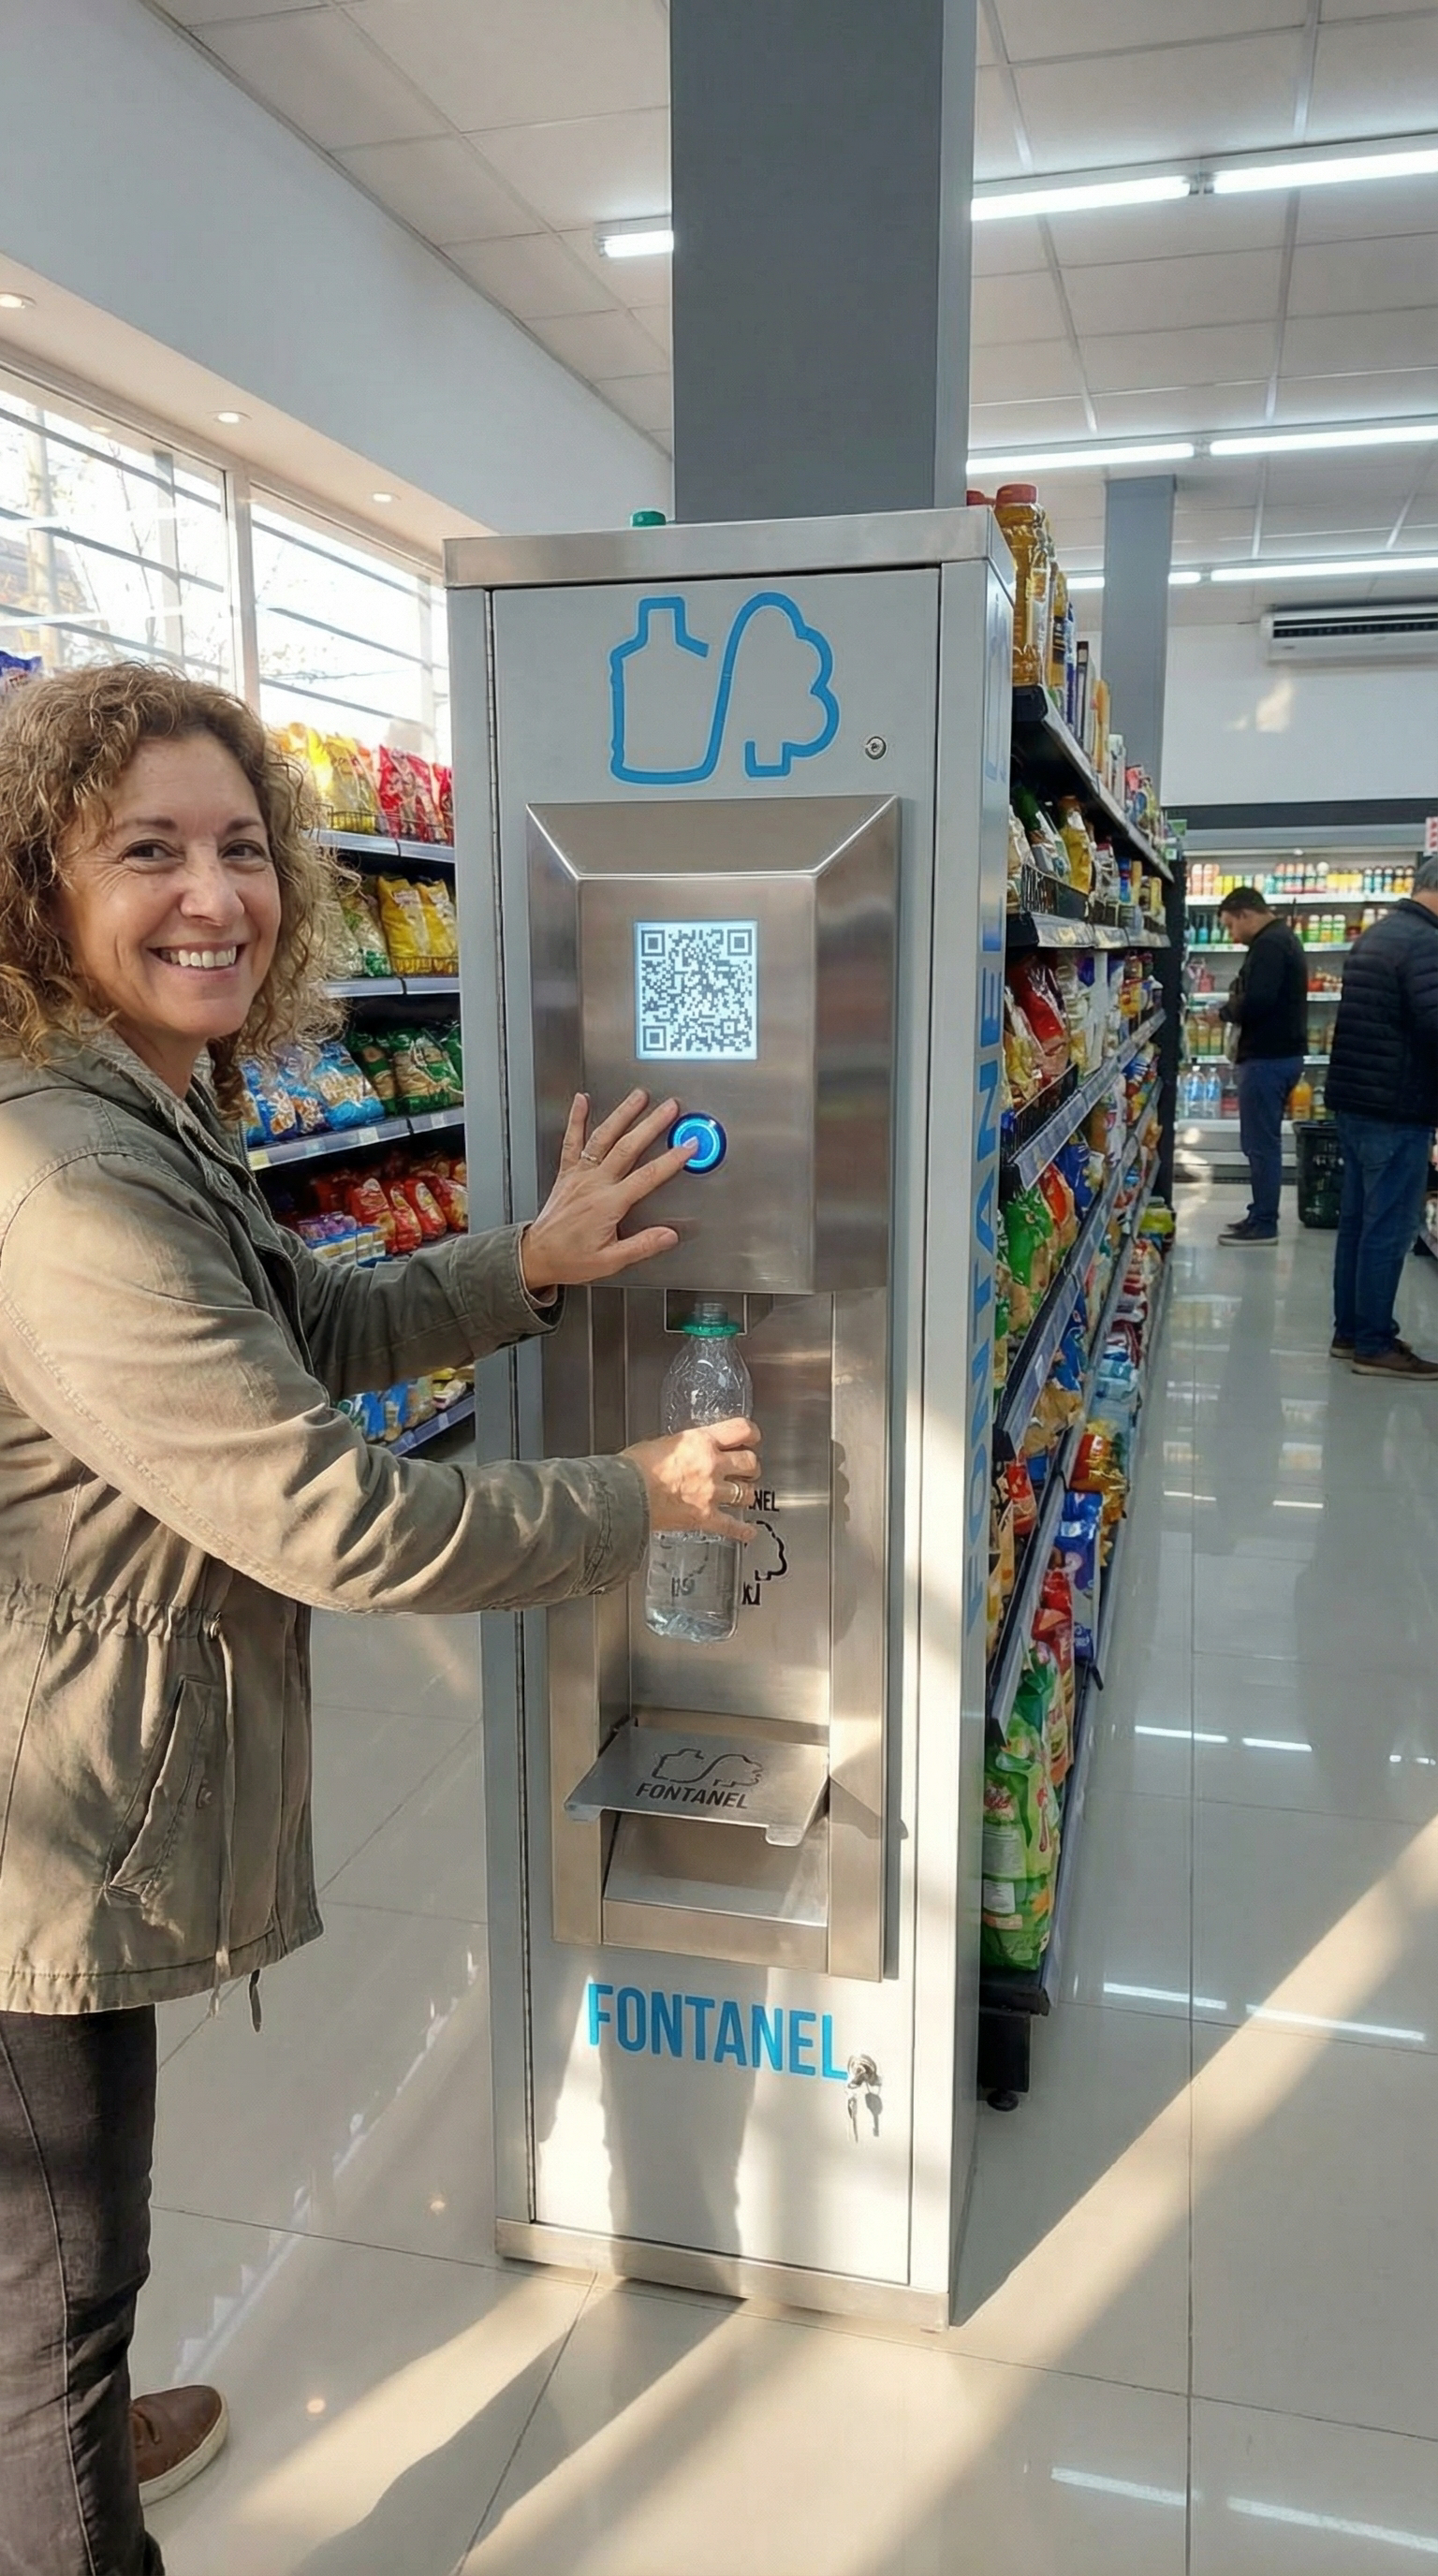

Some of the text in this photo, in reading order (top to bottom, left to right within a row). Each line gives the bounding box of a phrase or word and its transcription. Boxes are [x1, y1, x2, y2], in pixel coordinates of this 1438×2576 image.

[967, 896, 1003, 1635] FONTANEL
[636, 1782, 748, 1809] FONTANEL
[588, 1983, 848, 2080] FONTANEL
